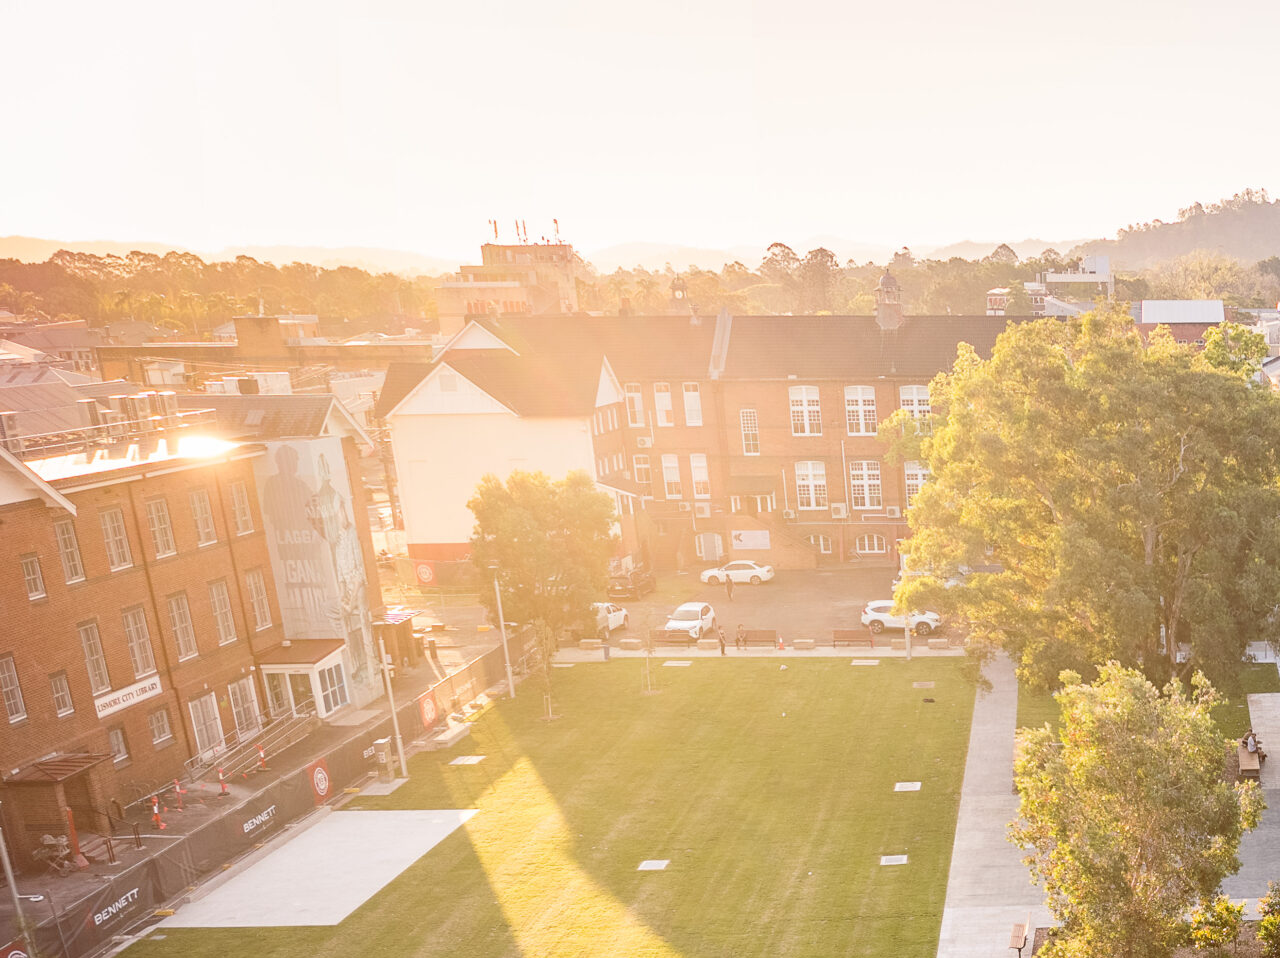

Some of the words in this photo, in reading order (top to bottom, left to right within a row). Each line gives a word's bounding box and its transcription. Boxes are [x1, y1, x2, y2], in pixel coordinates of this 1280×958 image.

[97, 696, 122, 713] LISMORE
[122, 692, 135, 702] CITY
[135, 682, 158, 697] LIBRARY
[243, 804, 277, 833] BENNETT
[93, 887, 139, 926] BENNETT
